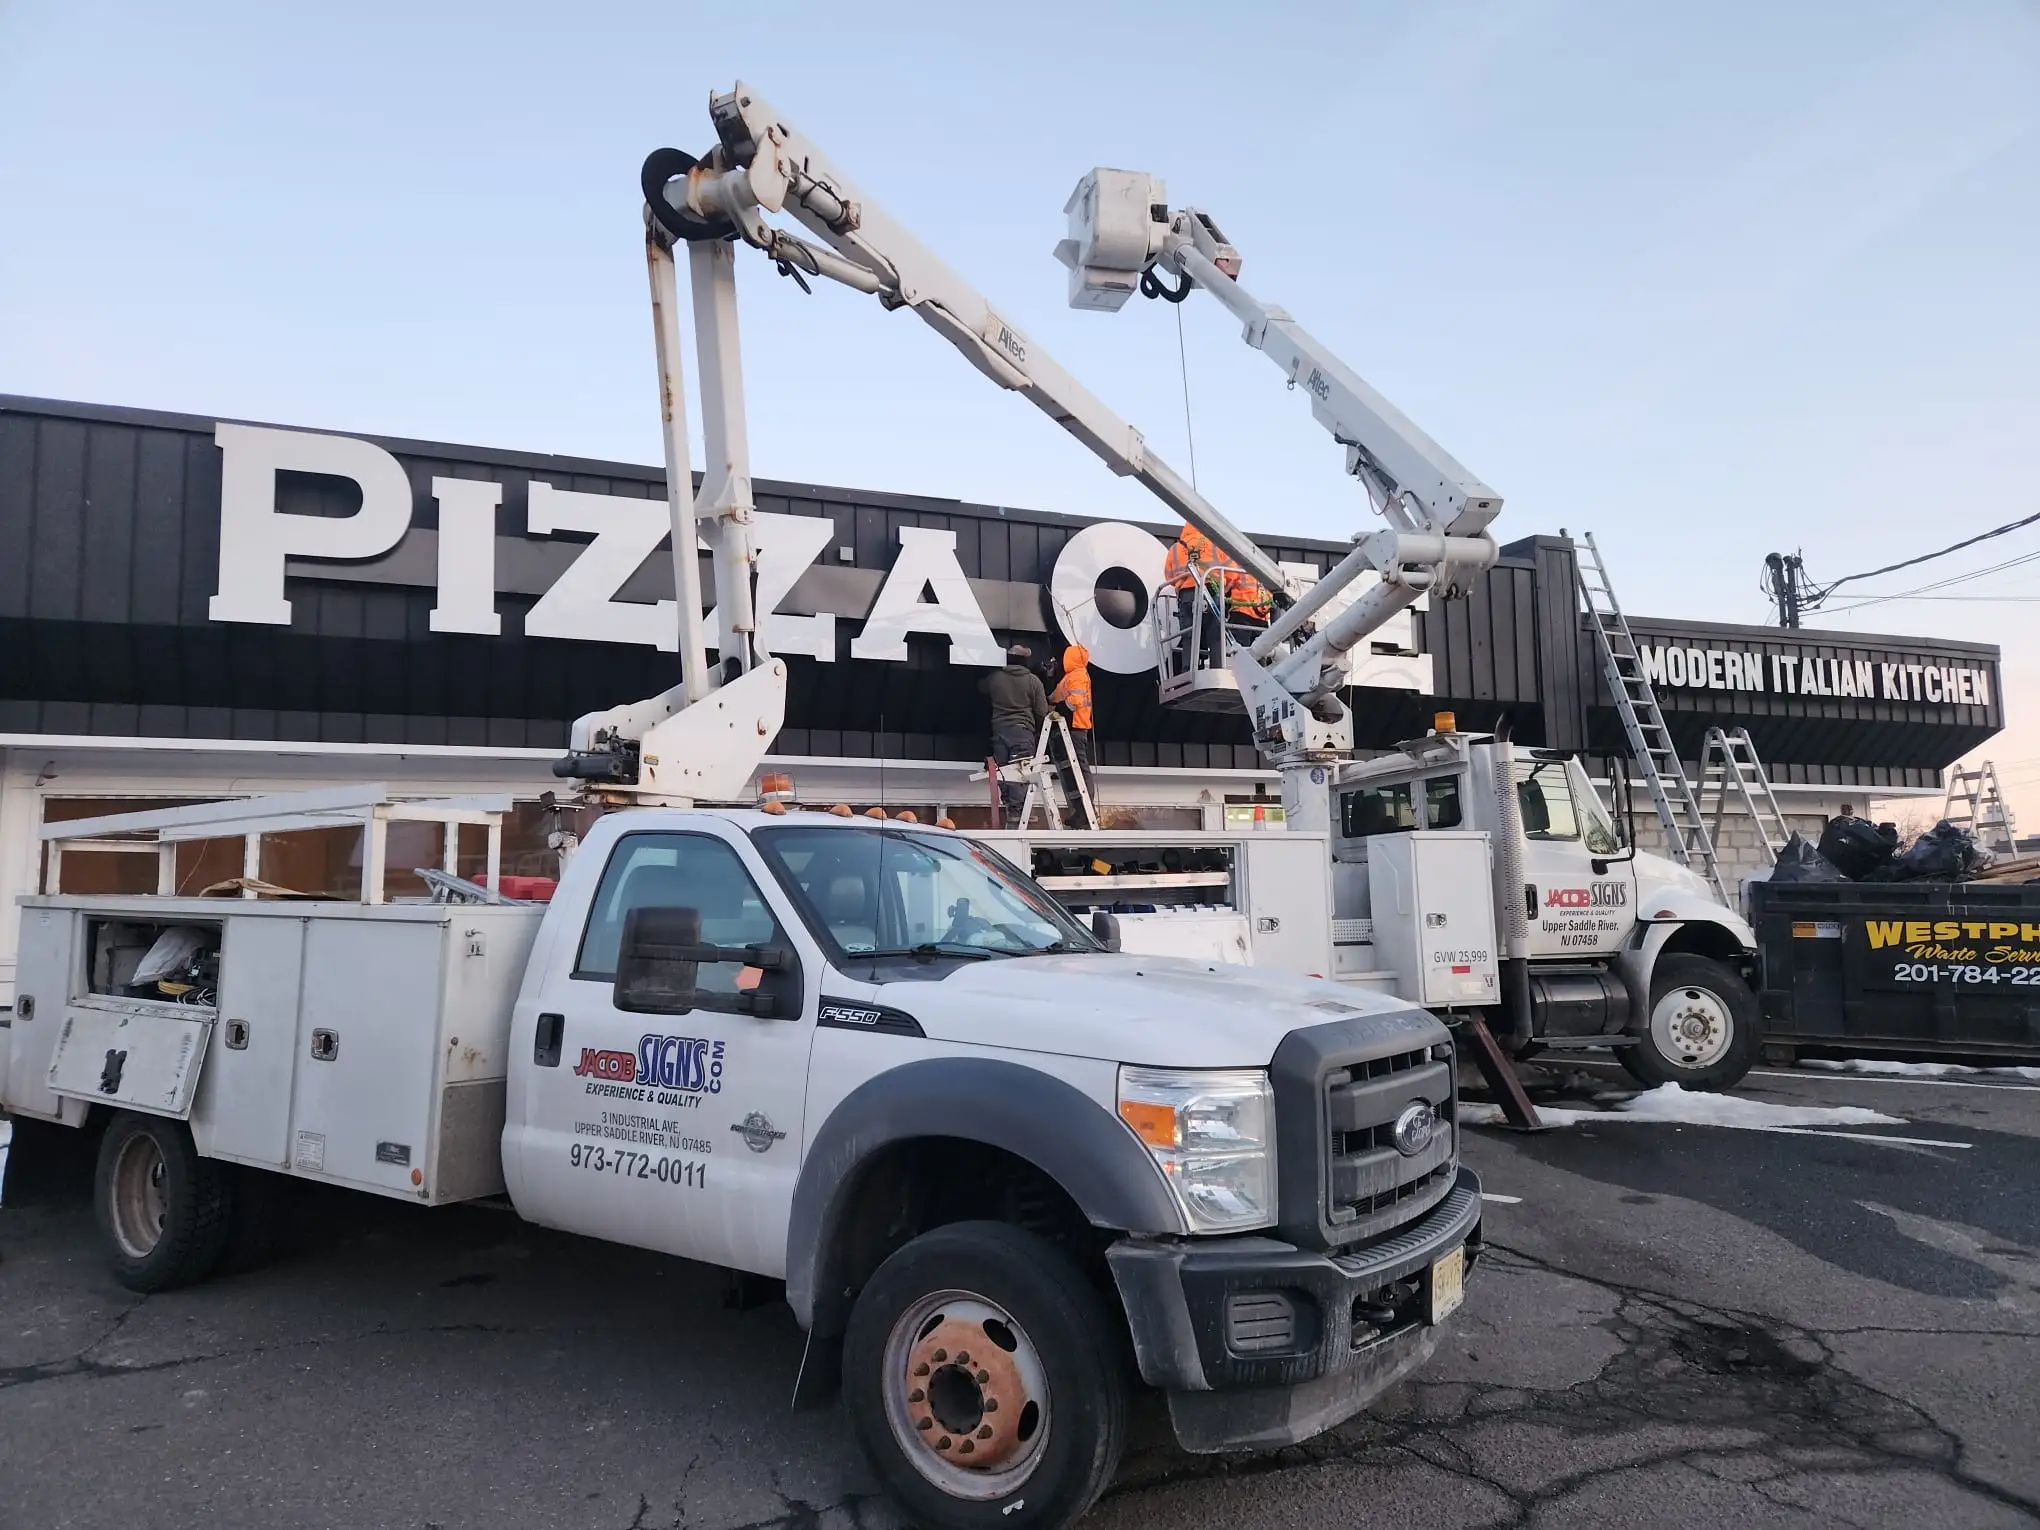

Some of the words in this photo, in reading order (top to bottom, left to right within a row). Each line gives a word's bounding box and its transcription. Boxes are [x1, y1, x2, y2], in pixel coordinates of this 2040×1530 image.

[998, 326, 1026, 362] Altec
[1306, 367, 1330, 401] Altec
[209, 422, 1007, 668] PIZZA
[1051, 522, 1434, 696] OE
[1640, 644, 1765, 692] MODERN
[1771, 654, 1875, 699] ITALIAN
[1881, 662, 1990, 706] KITCHEN
[1543, 888, 1591, 908] JACOB
[1590, 881, 1628, 908] SIGNS
[1542, 919, 1567, 934] Upper
[1568, 919, 1596, 932] Saddle
[1560, 934, 1571, 947] NJ
[1572, 934, 1599, 946] 07458
[1904, 943, 1978, 961] Waste
[1433, 951, 1457, 963] GVW
[1458, 950, 1488, 965] 25,999
[1894, 963, 2040, 986] 201-784-22
[573, 1047, 637, 1082] JACOB
[635, 1033, 709, 1093] SIGNS
[585, 1082, 646, 1102] EXPERIENCE
[646, 1089, 655, 1103] &
[657, 1092, 703, 1109] QUALITY
[601, 1111, 608, 1124] 3
[609, 1112, 660, 1132] INDUSTRIAL
[661, 1119, 681, 1136] AVE,
[574, 1121, 602, 1137] UPPER
[603, 1126, 637, 1143] SADDLE
[639, 1131, 668, 1149] RIVER,
[669, 1135, 680, 1150] NJ
[681, 1137, 712, 1154] 07485
[570, 1143, 706, 1189] 973-772-0011
